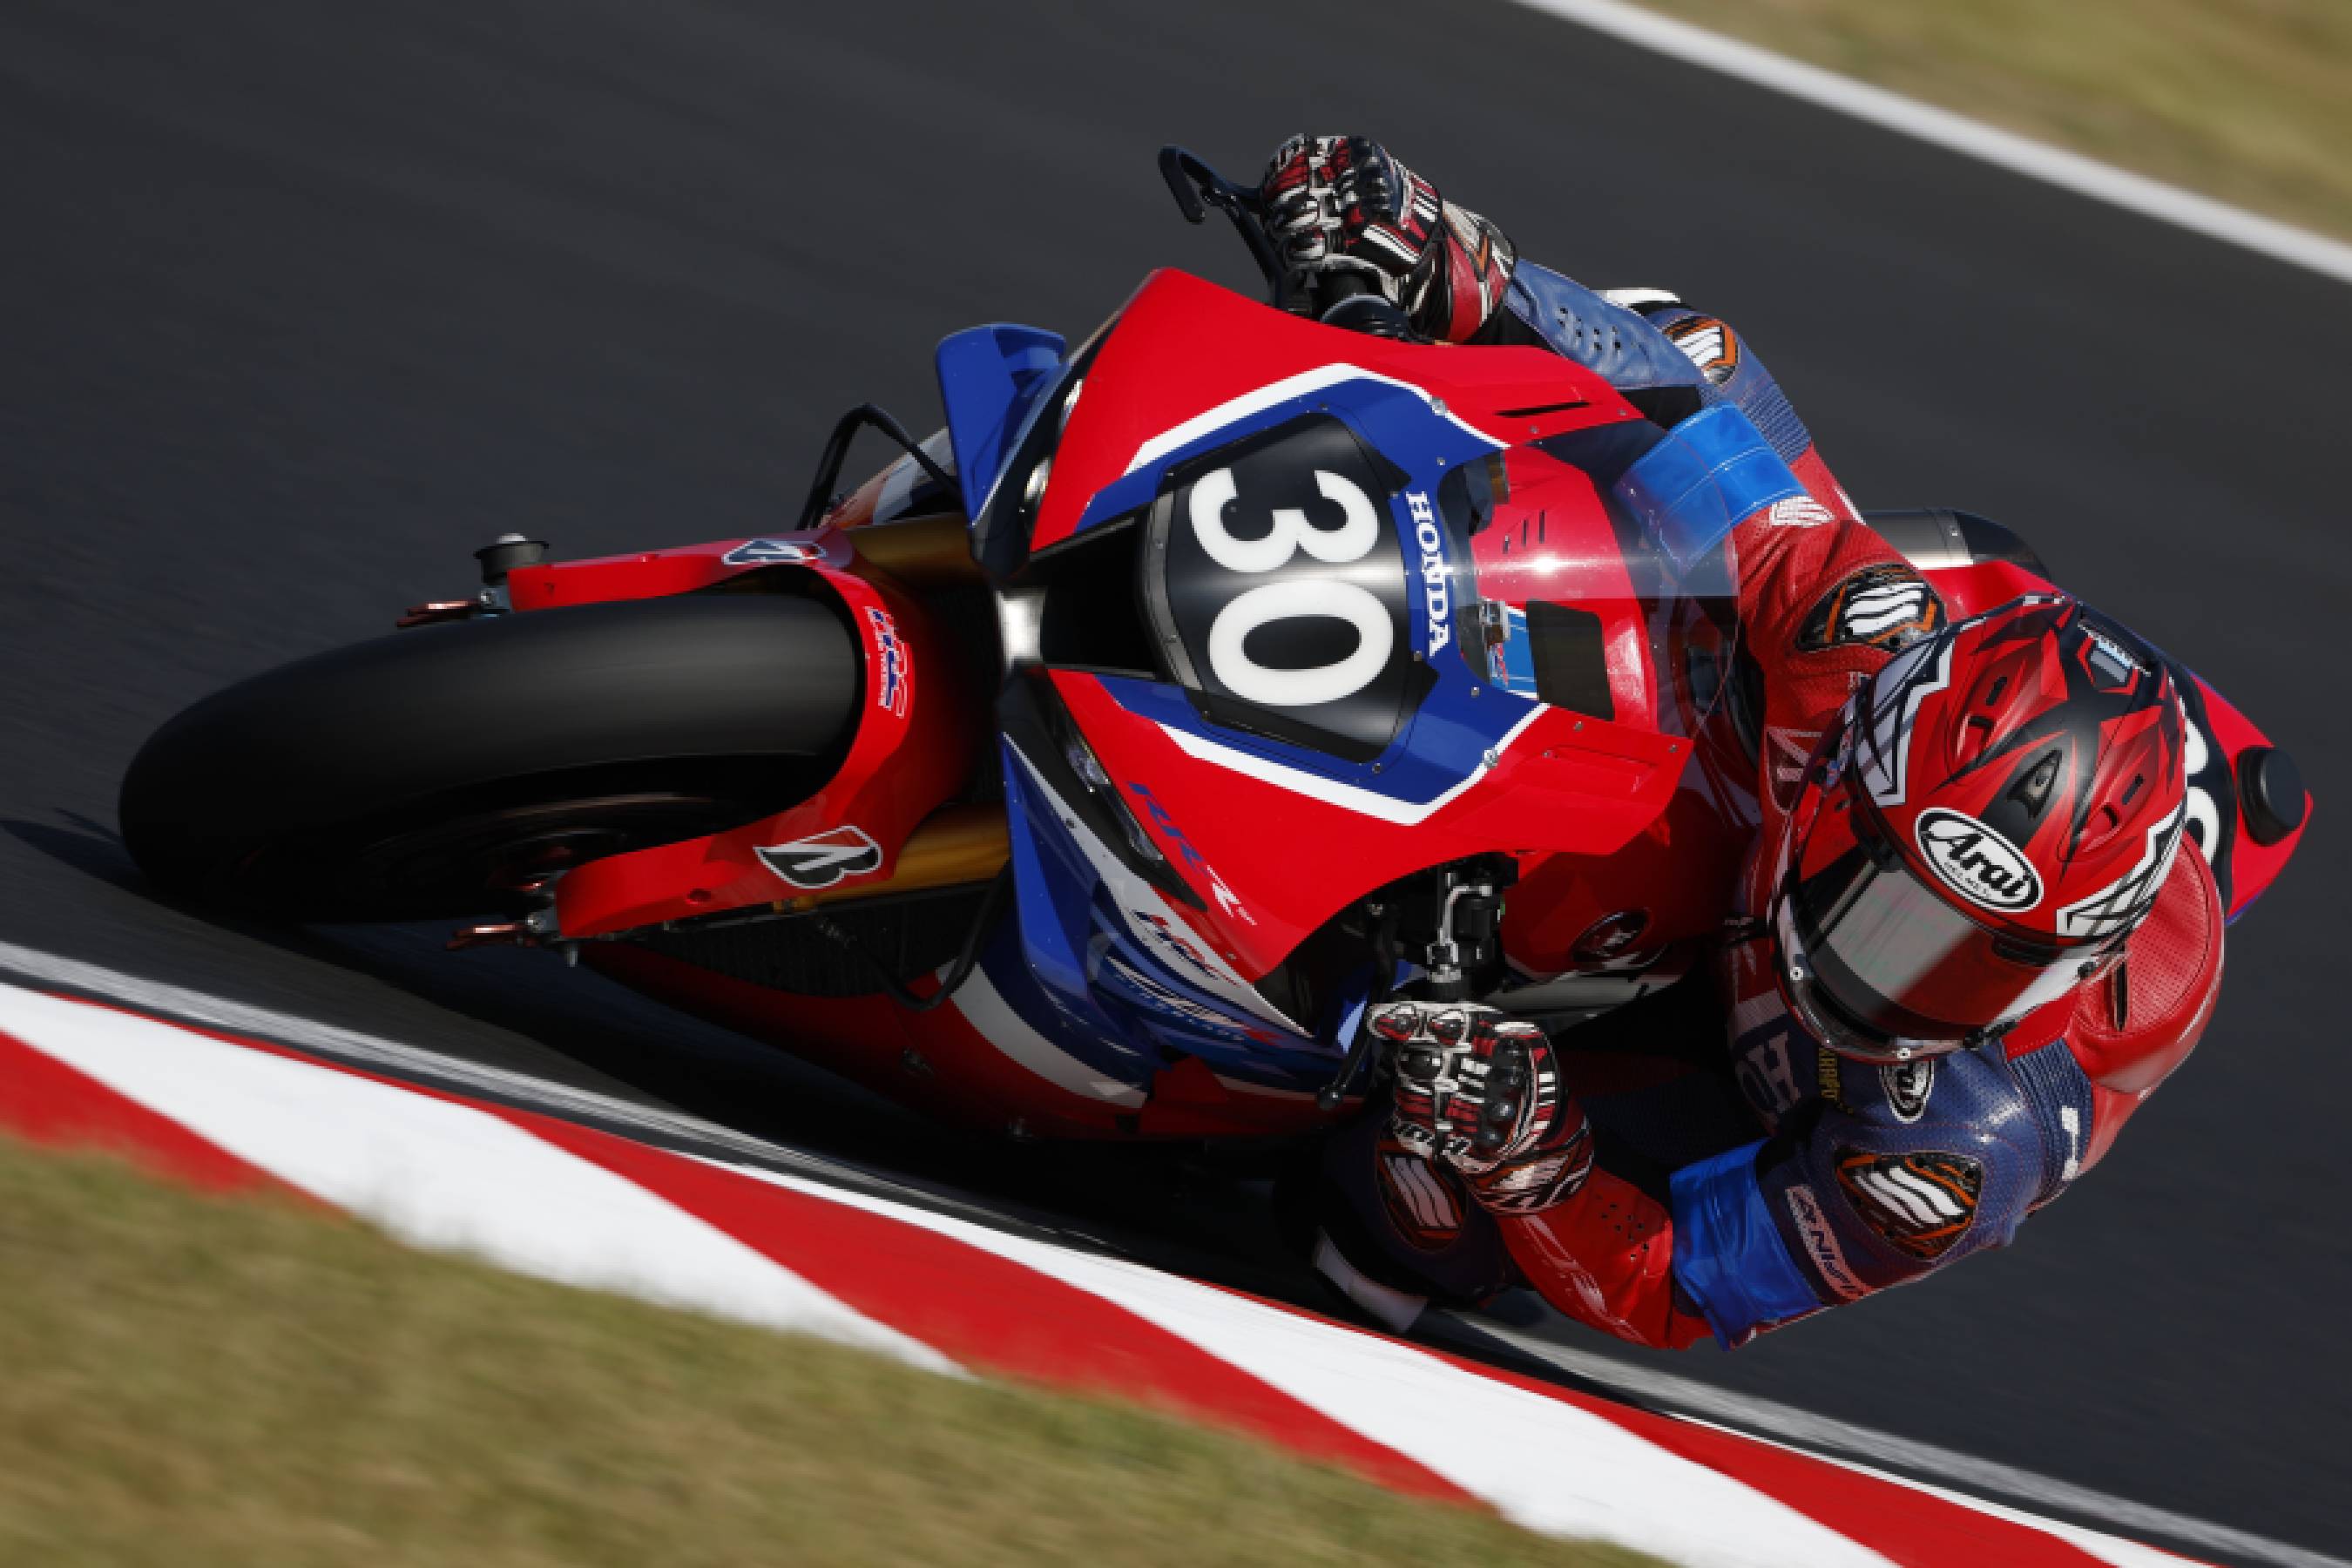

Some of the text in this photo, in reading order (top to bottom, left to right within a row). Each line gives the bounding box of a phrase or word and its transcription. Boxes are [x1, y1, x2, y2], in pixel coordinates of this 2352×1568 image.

[1189, 467, 1394, 706] 30
[1405, 490, 1450, 657] HONDA
[1924, 832, 2028, 897] Arai
